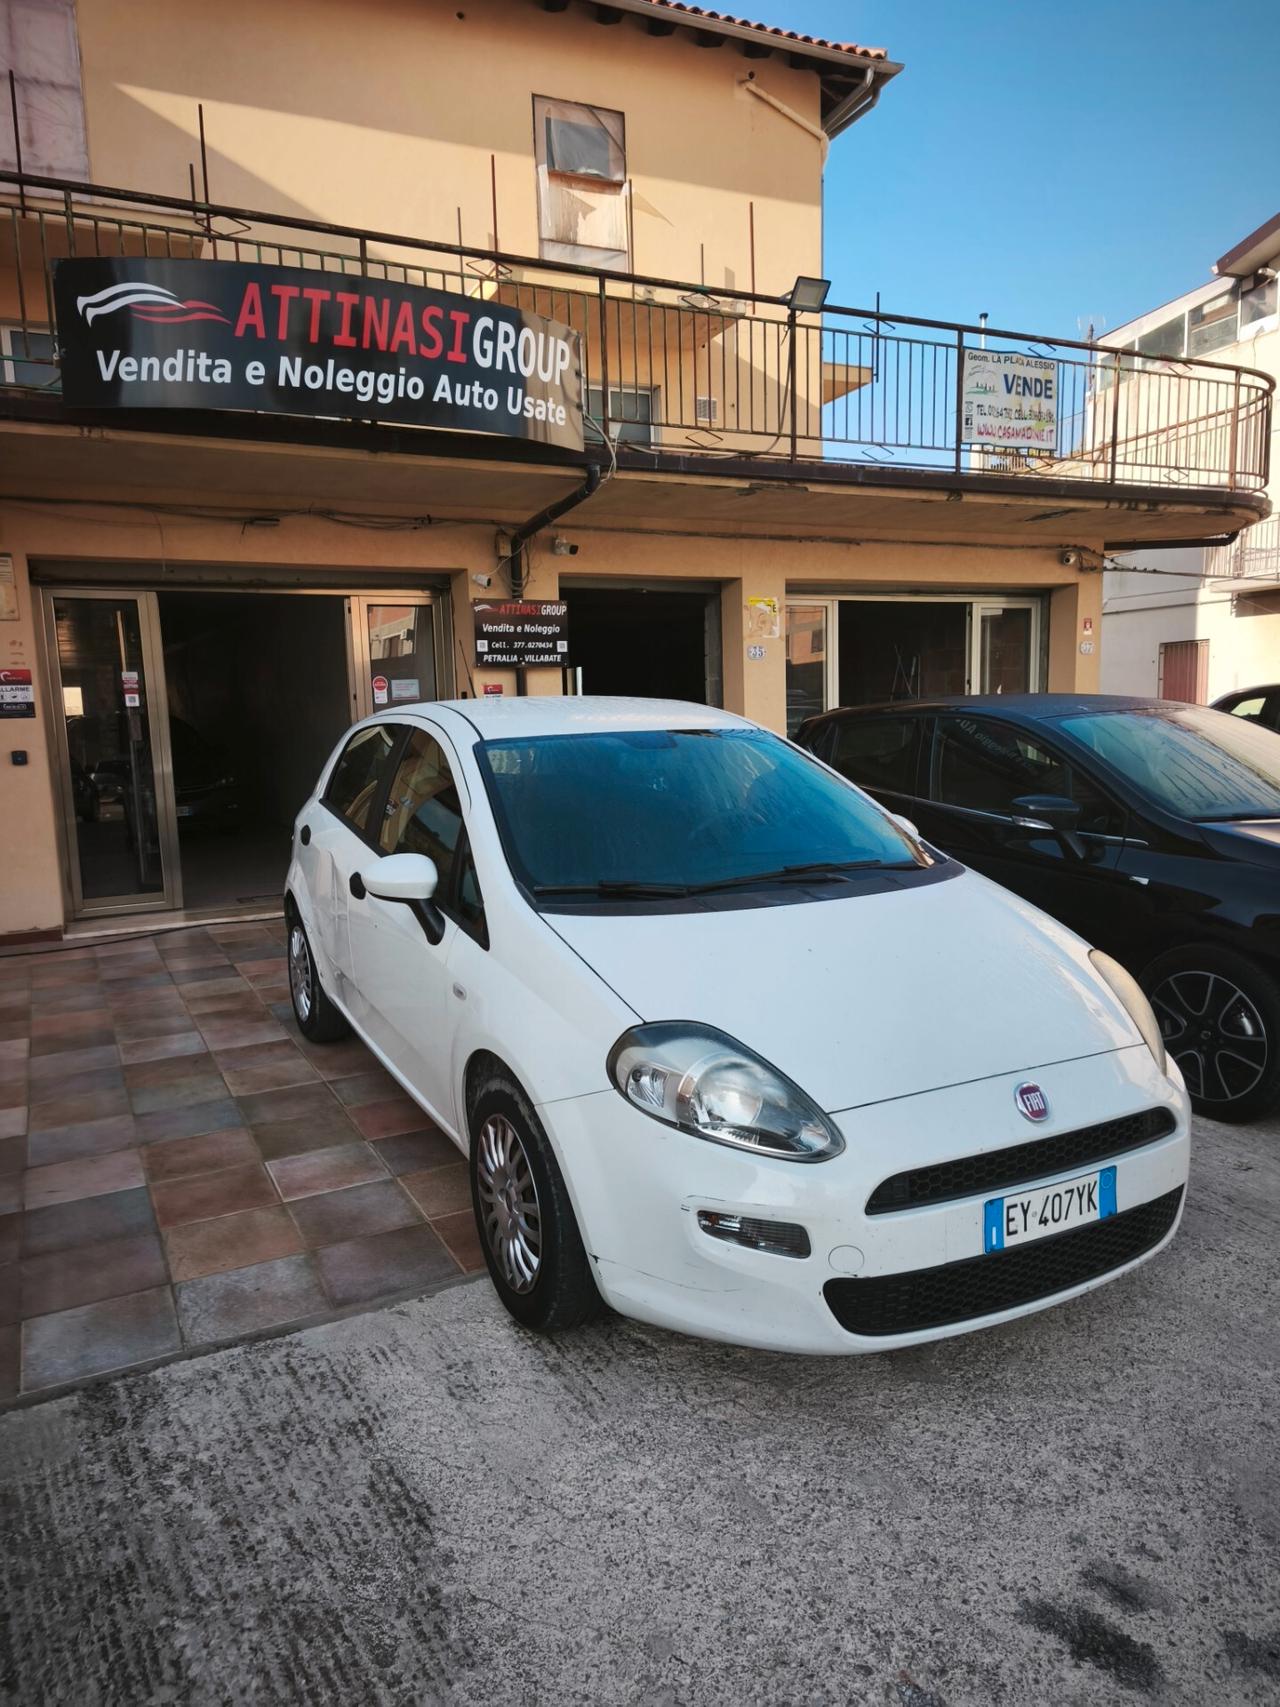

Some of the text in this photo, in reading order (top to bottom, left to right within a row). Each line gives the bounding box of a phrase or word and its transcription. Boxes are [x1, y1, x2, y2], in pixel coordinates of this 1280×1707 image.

[991, 355, 1002, 365] LA
[1025, 360, 1055, 370] ALESSIO
[96, 349, 567, 426] Vendita e Noleggio Auto Usate
[1003, 373, 1053, 399] VENDE
[482, 623, 515, 632] Vendita
[524, 624, 560, 635] Noleggio
[483, 654, 518, 662] PETRALIA
[1023, 1091, 1045, 1112] FIAT
[1006, 1180, 1098, 1236] EY 407YK
